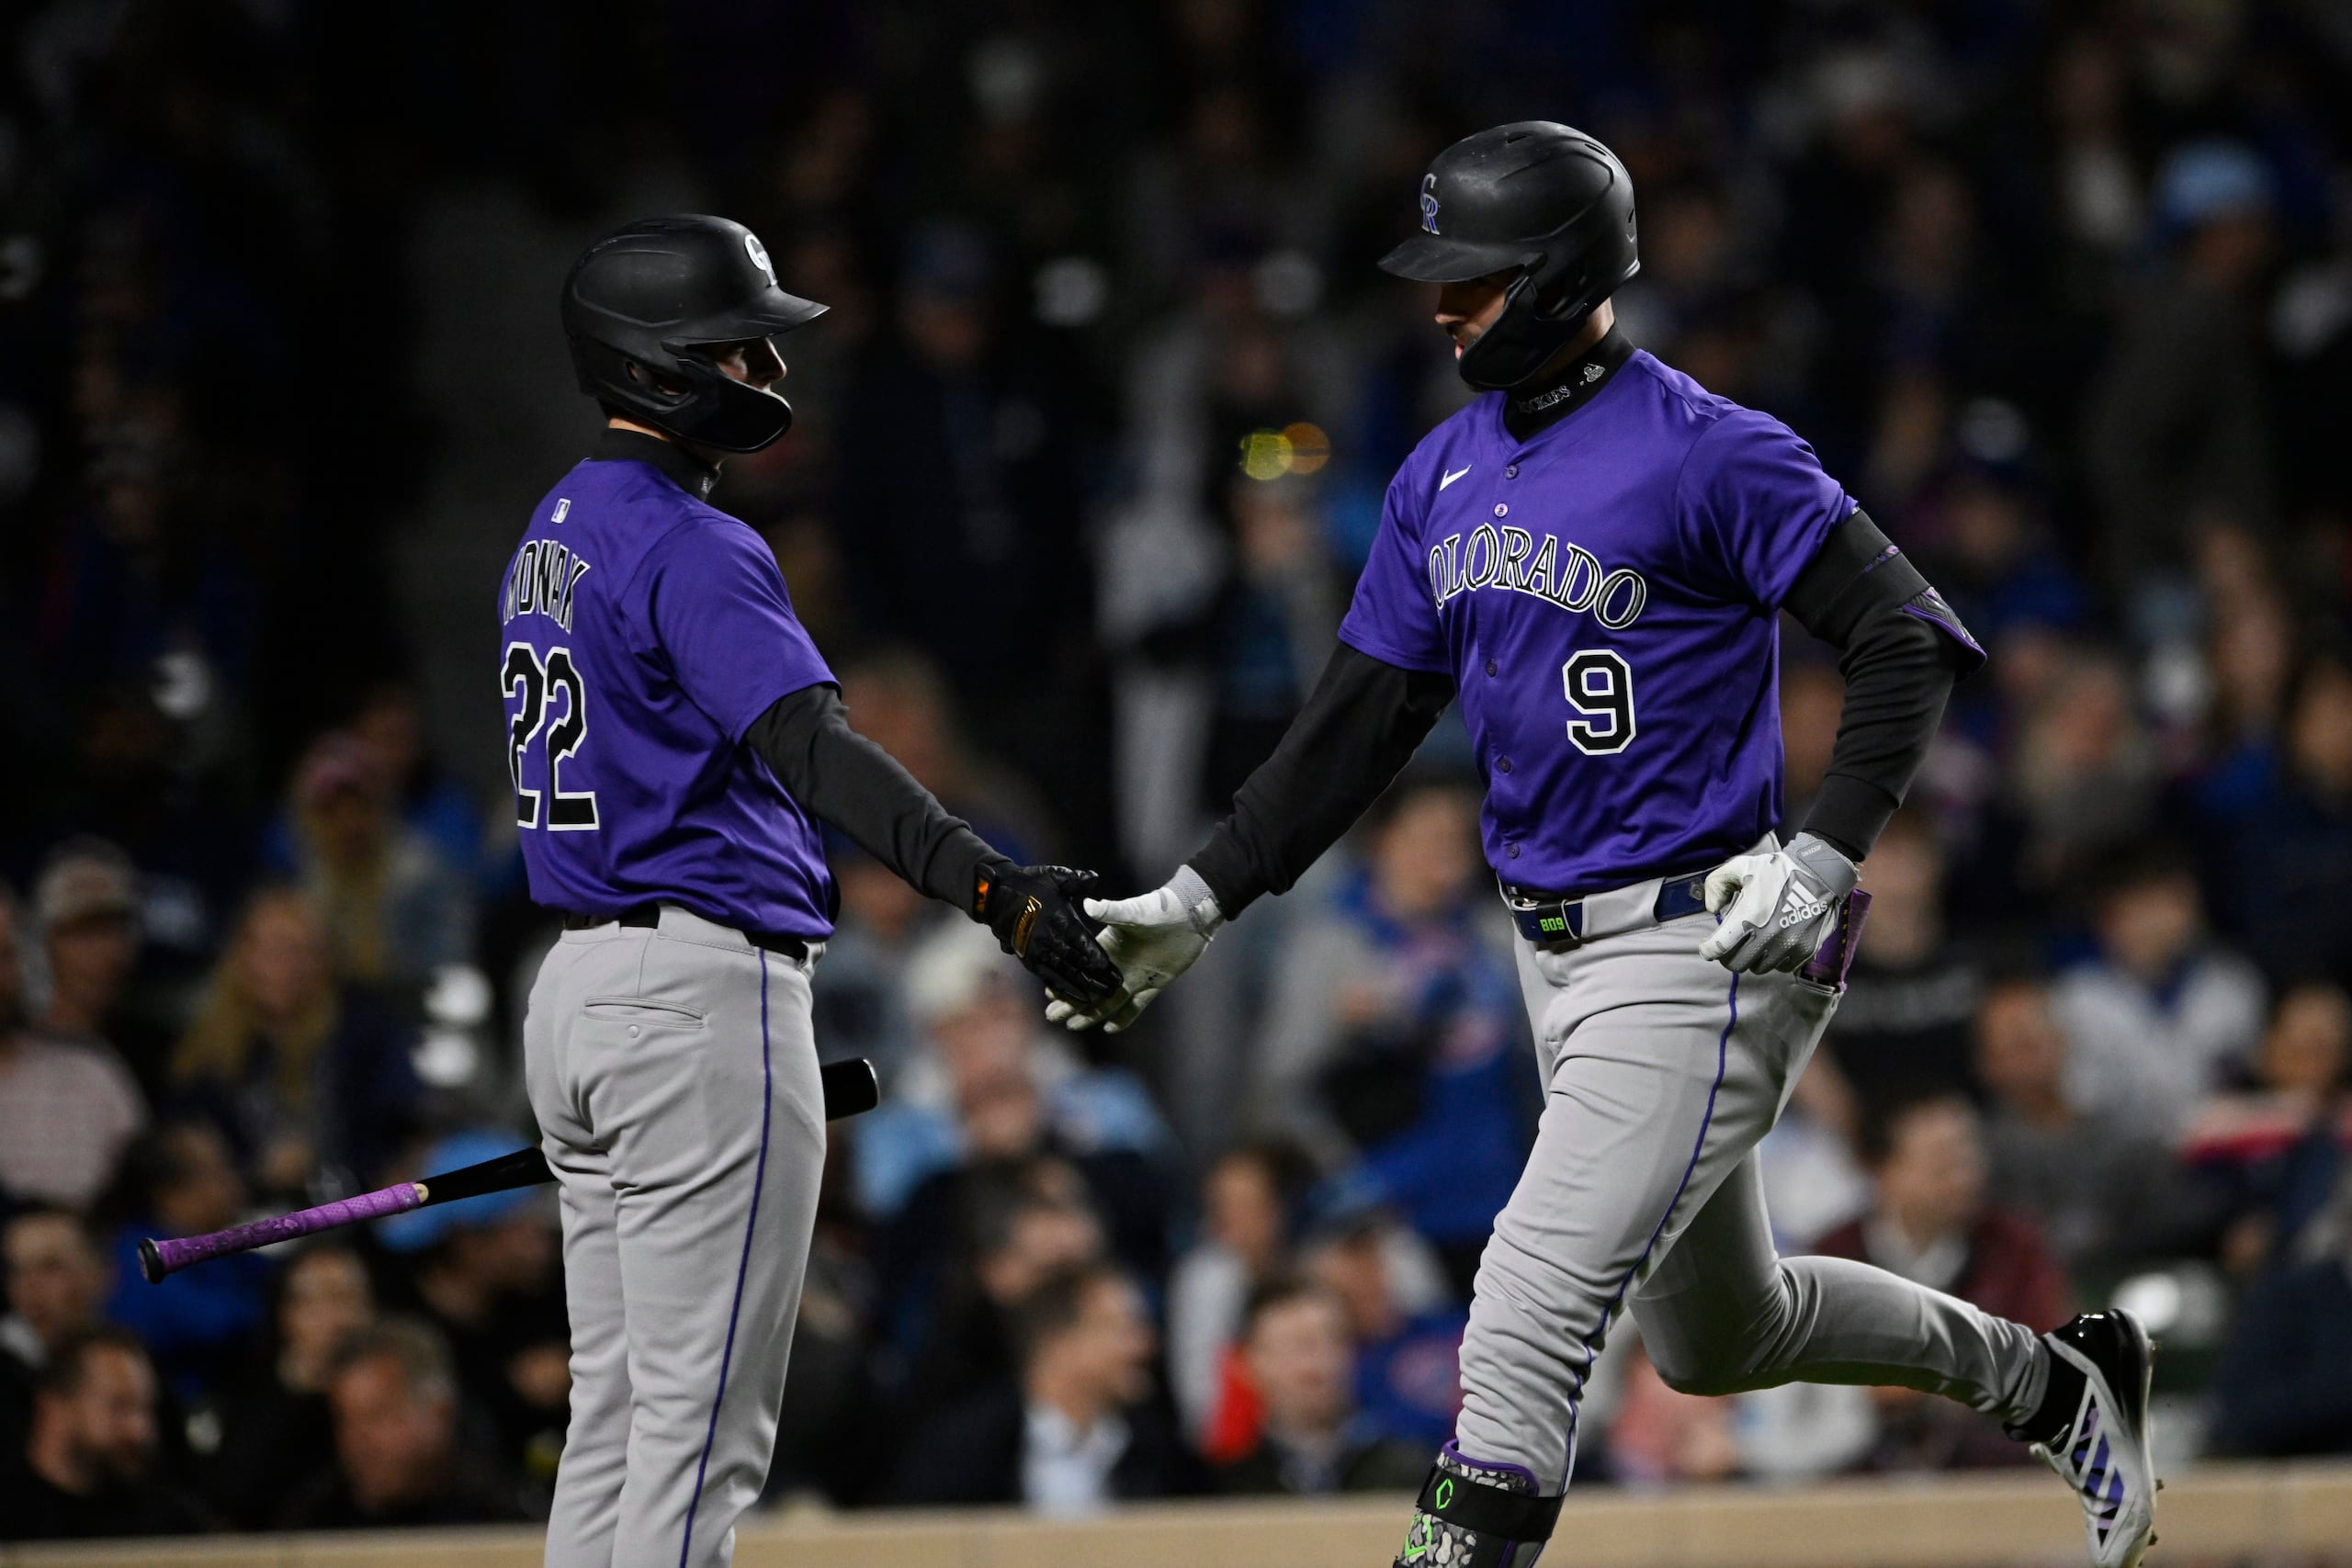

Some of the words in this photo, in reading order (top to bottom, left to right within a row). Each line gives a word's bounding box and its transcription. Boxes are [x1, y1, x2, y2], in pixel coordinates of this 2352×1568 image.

[1419, 173, 1440, 235] CR
[1516, 386, 1570, 412] OCKIES
[1430, 523, 1646, 629] OLORADO
[501, 642, 600, 831] 22
[1562, 649, 1636, 755] 9
[1780, 900, 1828, 929] adidas
